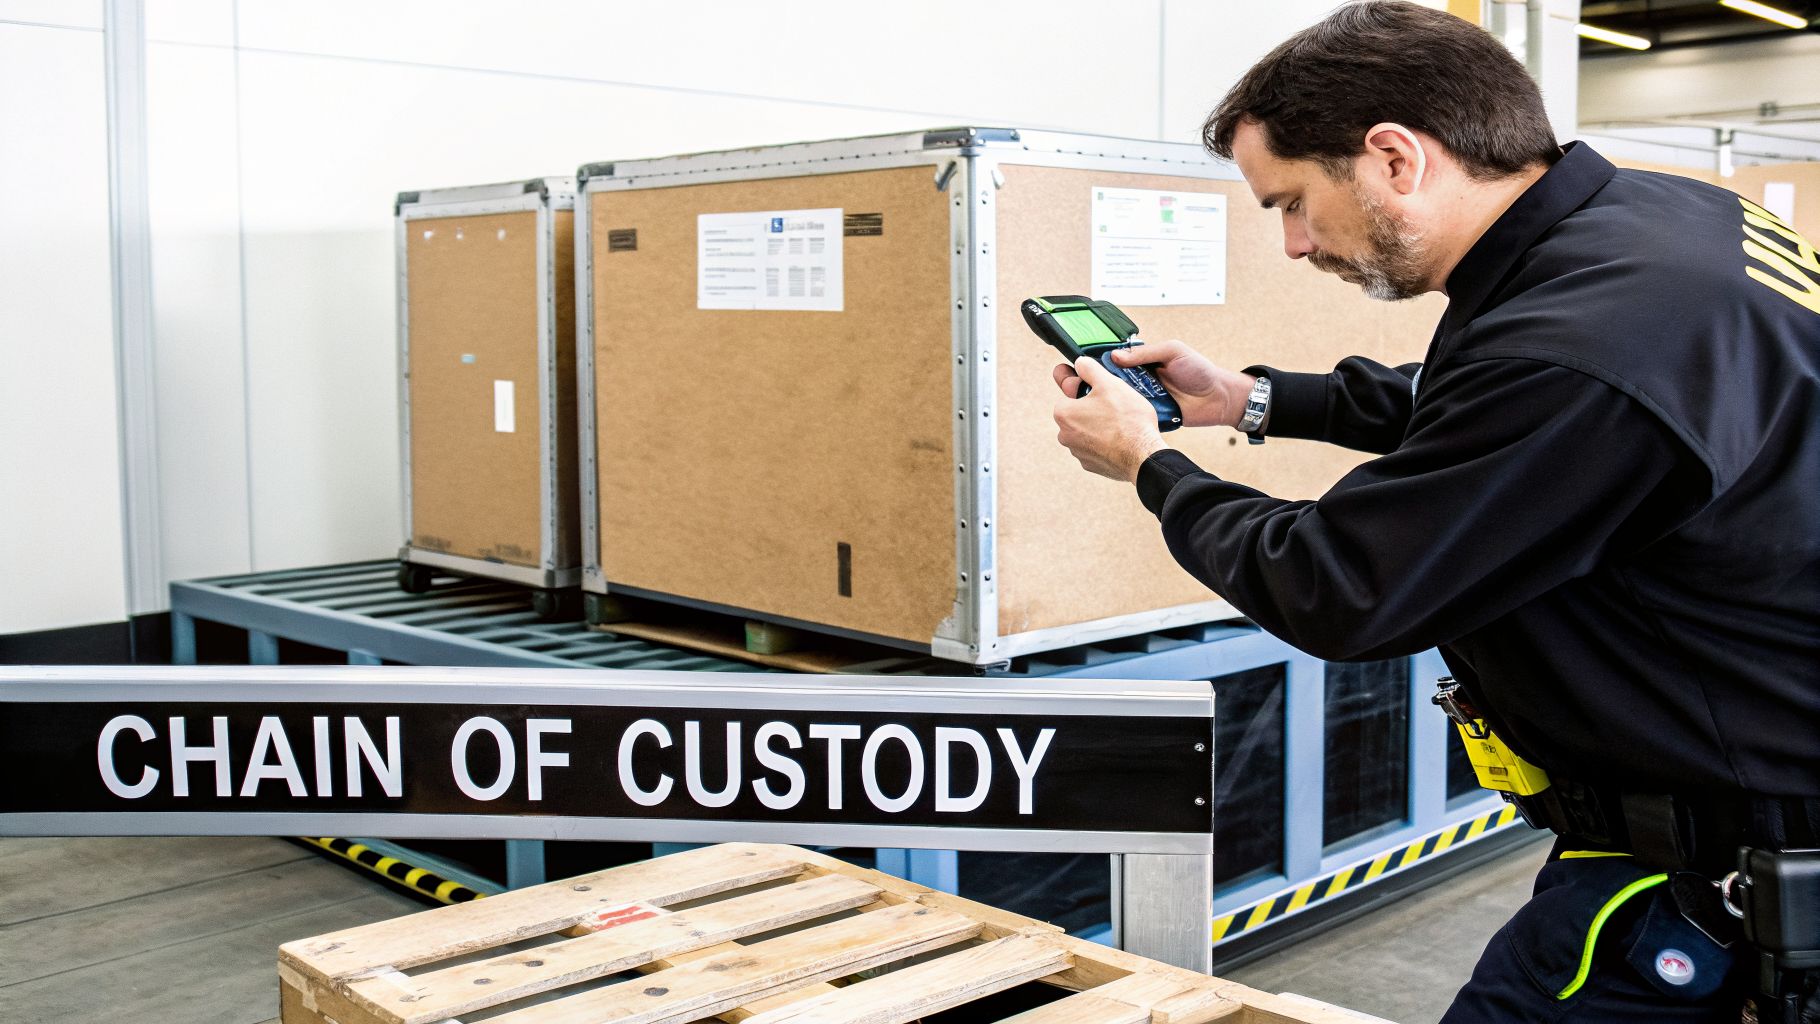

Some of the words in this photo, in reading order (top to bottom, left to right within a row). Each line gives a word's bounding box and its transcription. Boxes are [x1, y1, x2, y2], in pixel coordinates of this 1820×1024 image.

[97, 714, 403, 799] CHAIN
[451, 715, 573, 802] OF
[617, 718, 1057, 815] CUSTODY
